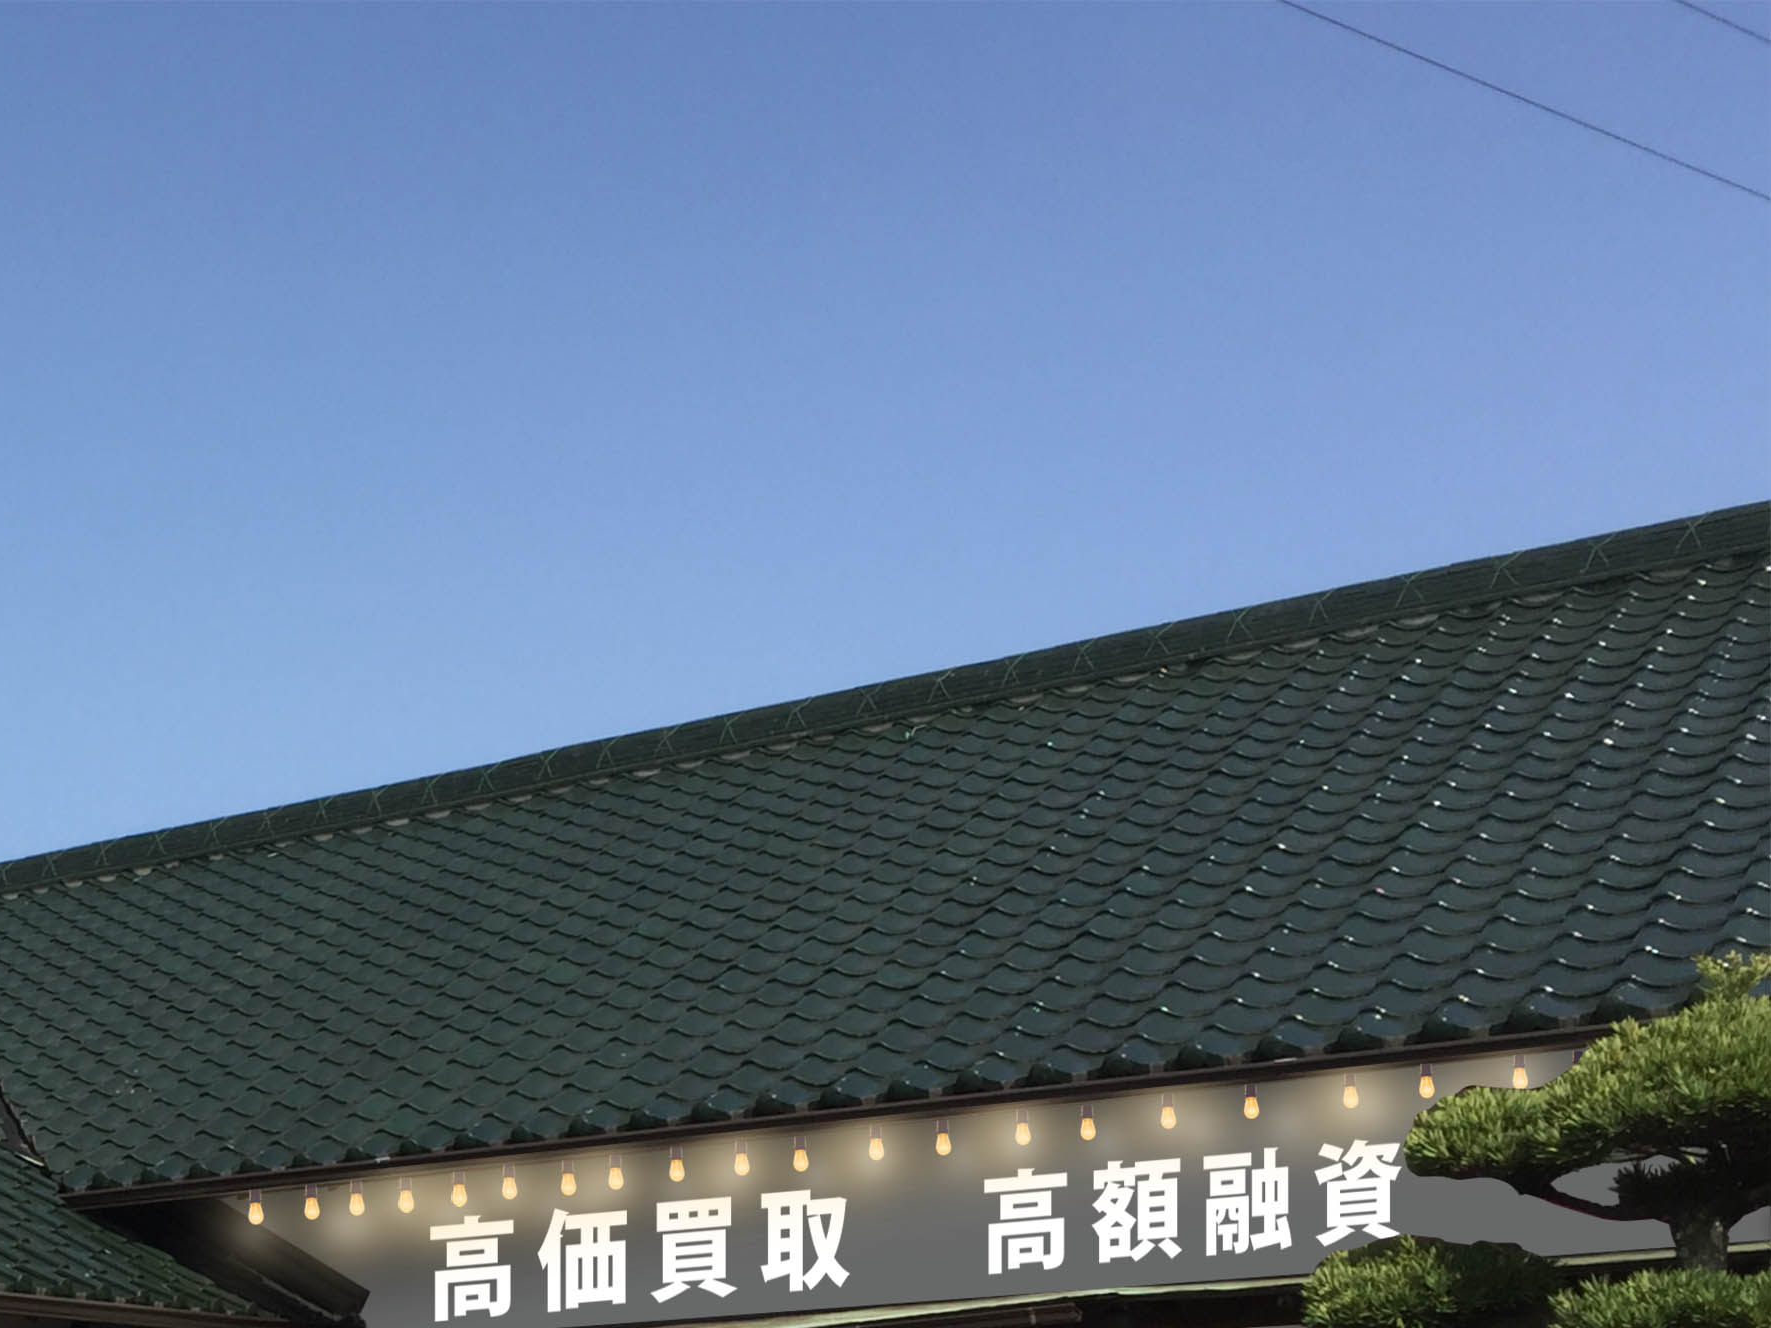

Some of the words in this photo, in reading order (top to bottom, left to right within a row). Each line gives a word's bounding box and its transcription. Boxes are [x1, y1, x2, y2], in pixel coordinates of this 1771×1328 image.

[430, 1190, 850, 1322] 高価買取
[984, 1139, 1402, 1275] 高額融資
